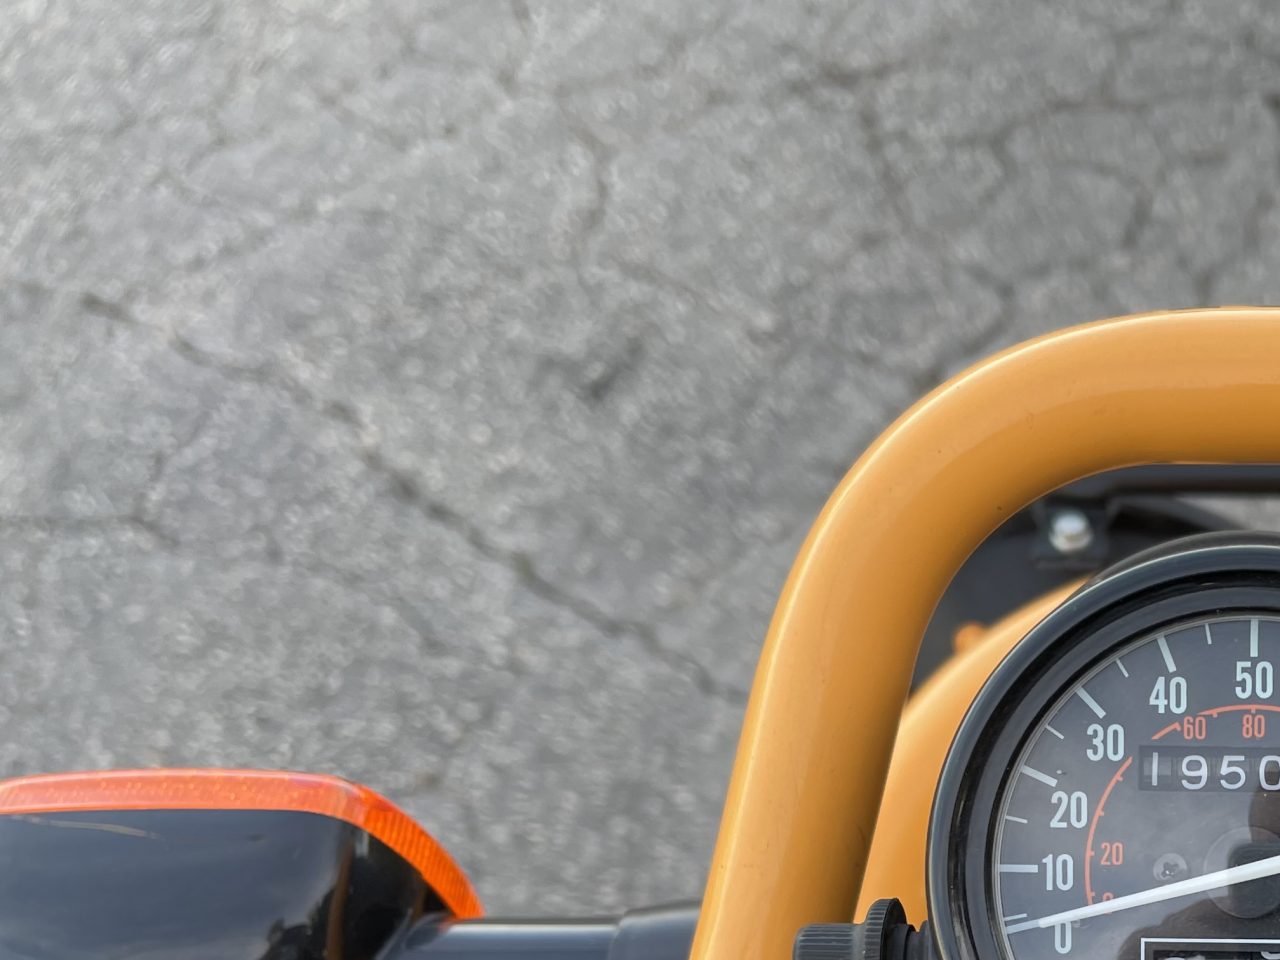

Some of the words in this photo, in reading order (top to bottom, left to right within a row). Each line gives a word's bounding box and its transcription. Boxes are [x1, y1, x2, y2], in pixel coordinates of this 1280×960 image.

[1149, 677, 1187, 714] 40
[1234, 661, 1274, 699] 50
[1086, 723, 1125, 761] 30
[1184, 716, 1207, 740] 60
[1242, 715, 1265, 738] 80
[1050, 791, 1088, 829] 20
[1042, 854, 1074, 891] 10
[1100, 842, 1123, 866] 20
[1054, 921, 1072, 953] 0
